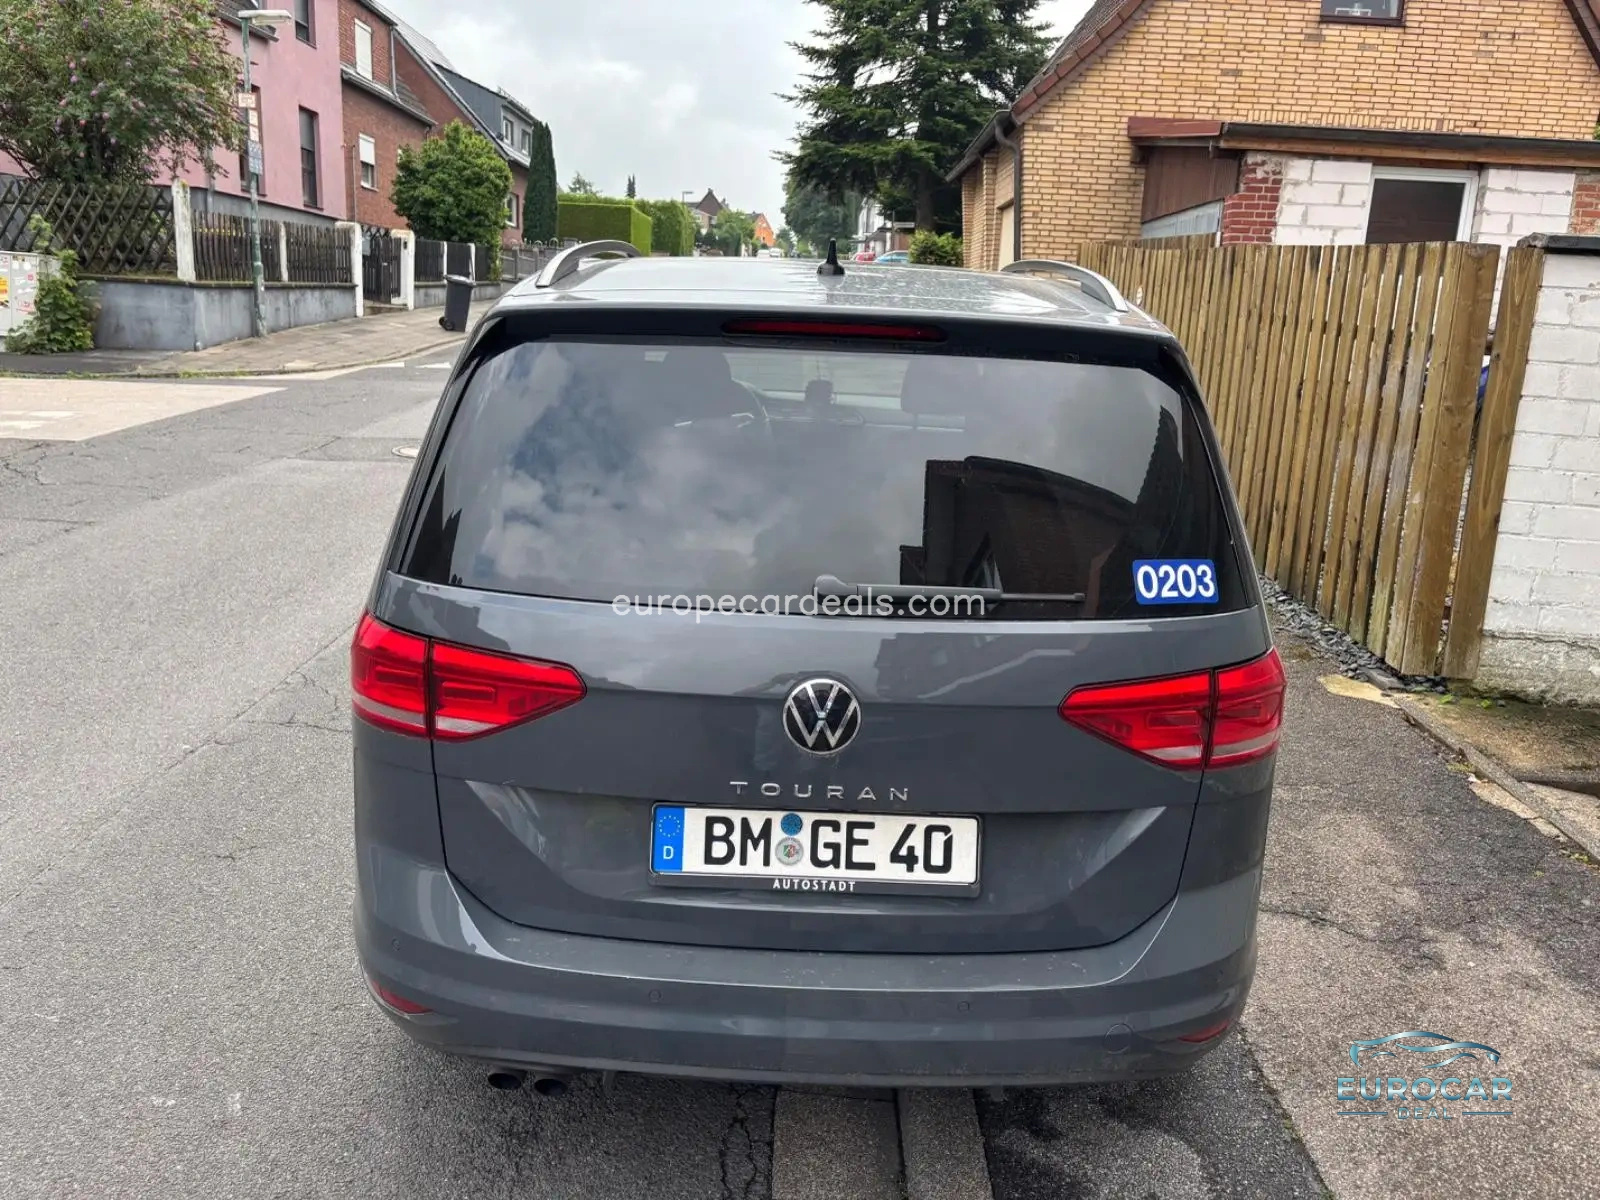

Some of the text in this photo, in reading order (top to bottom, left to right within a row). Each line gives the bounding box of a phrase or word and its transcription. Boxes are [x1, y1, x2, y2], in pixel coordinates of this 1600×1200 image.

[1137, 564, 1215, 599] 0203
[729, 781, 909, 802] TOURAN
[662, 846, 674, 860] D
[704, 815, 953, 874] BM GE 40
[772, 878, 857, 892] AUTOSTADT
